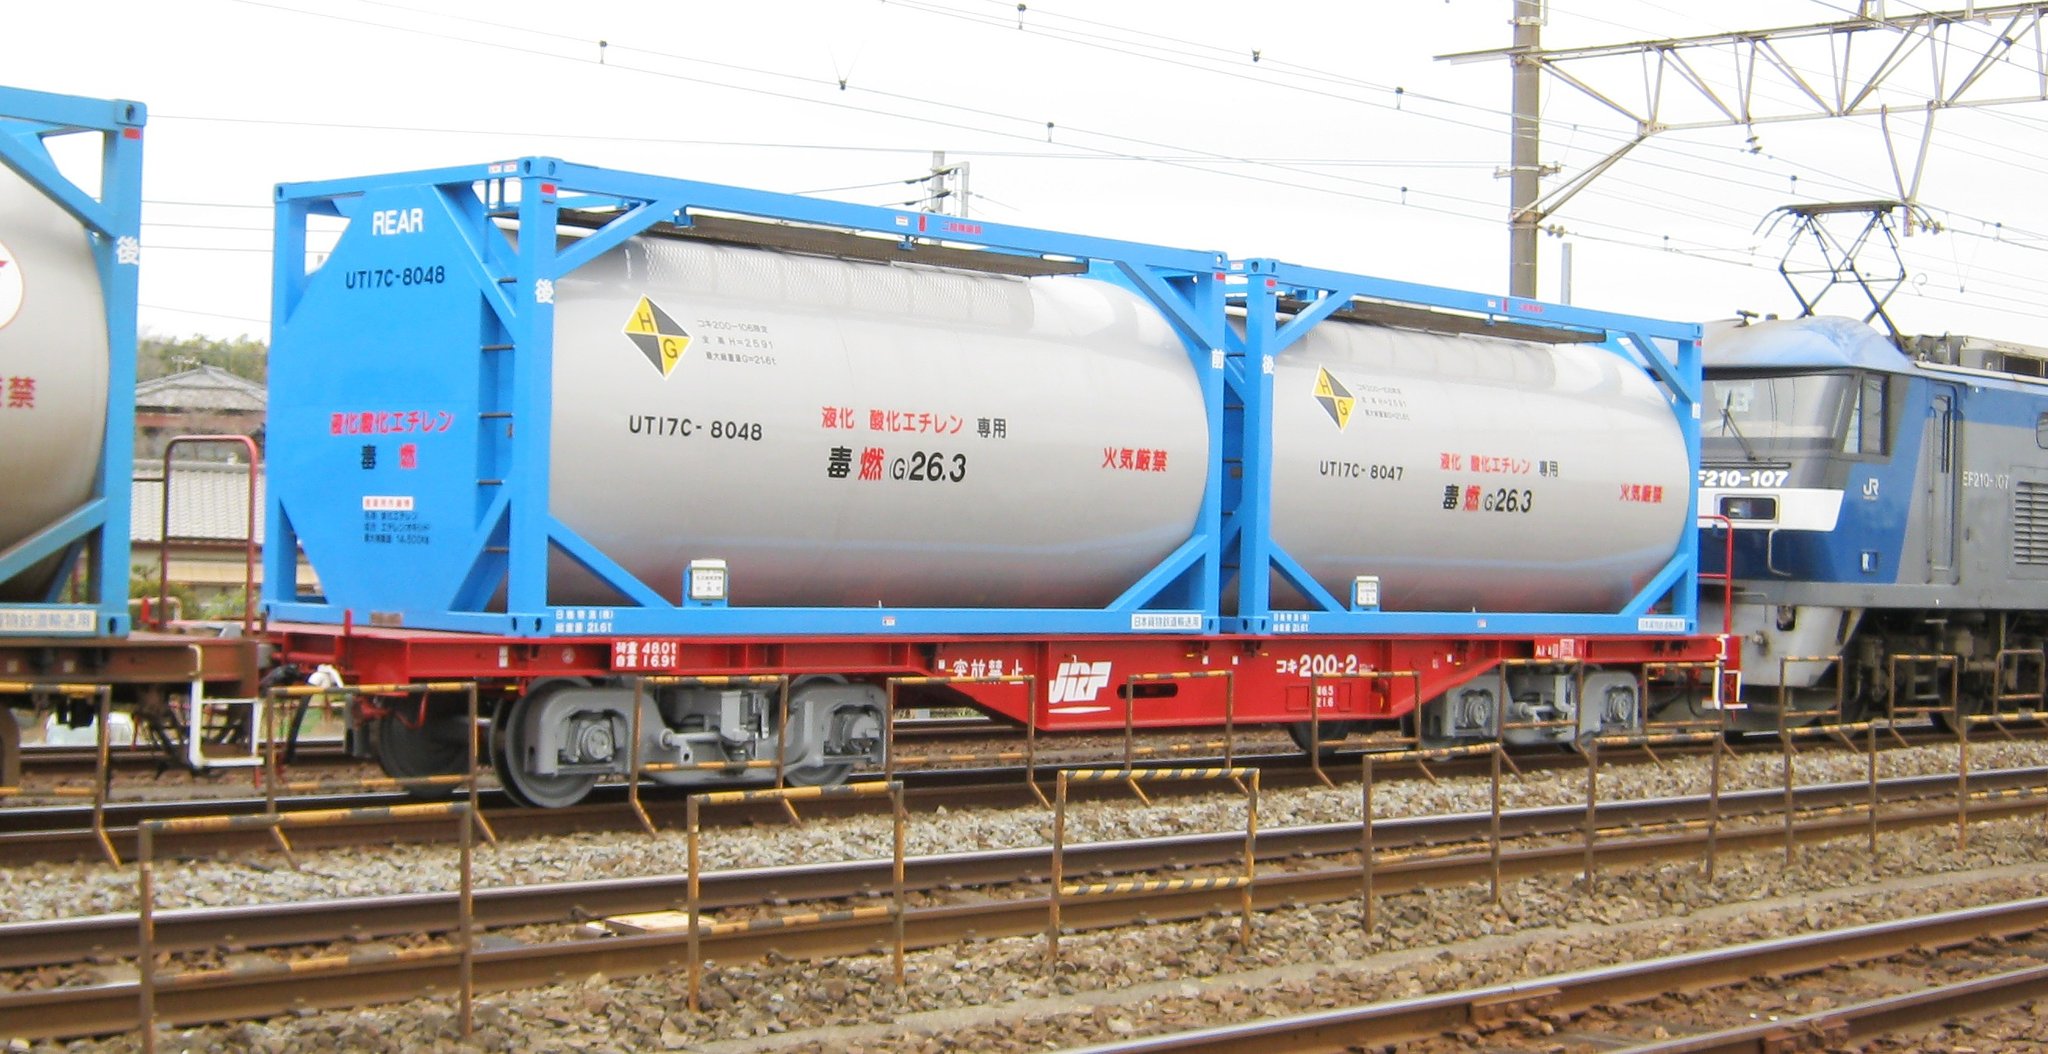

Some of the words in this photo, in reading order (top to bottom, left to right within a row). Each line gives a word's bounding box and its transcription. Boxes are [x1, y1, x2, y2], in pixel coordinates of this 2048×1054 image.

[372, 208, 424, 236] REAR
[117, 235, 140, 265] 後
[535, 279, 555, 304] 後
[638, 312, 655, 333] H
[663, 339, 678, 360] G
[0, 376, 35, 408] 禁
[1319, 379, 1332, 395] H
[1337, 399, 1348, 416] G
[822, 406, 854, 429] 液化
[869, 409, 963, 434] 酸化エチレン
[977, 417, 1007, 439] 専用
[827, 446, 852, 479] 毒
[858, 446, 885, 481] 燃
[1101, 446, 1168, 473] 火気厳禁
[1863, 478, 1879, 496] JR
